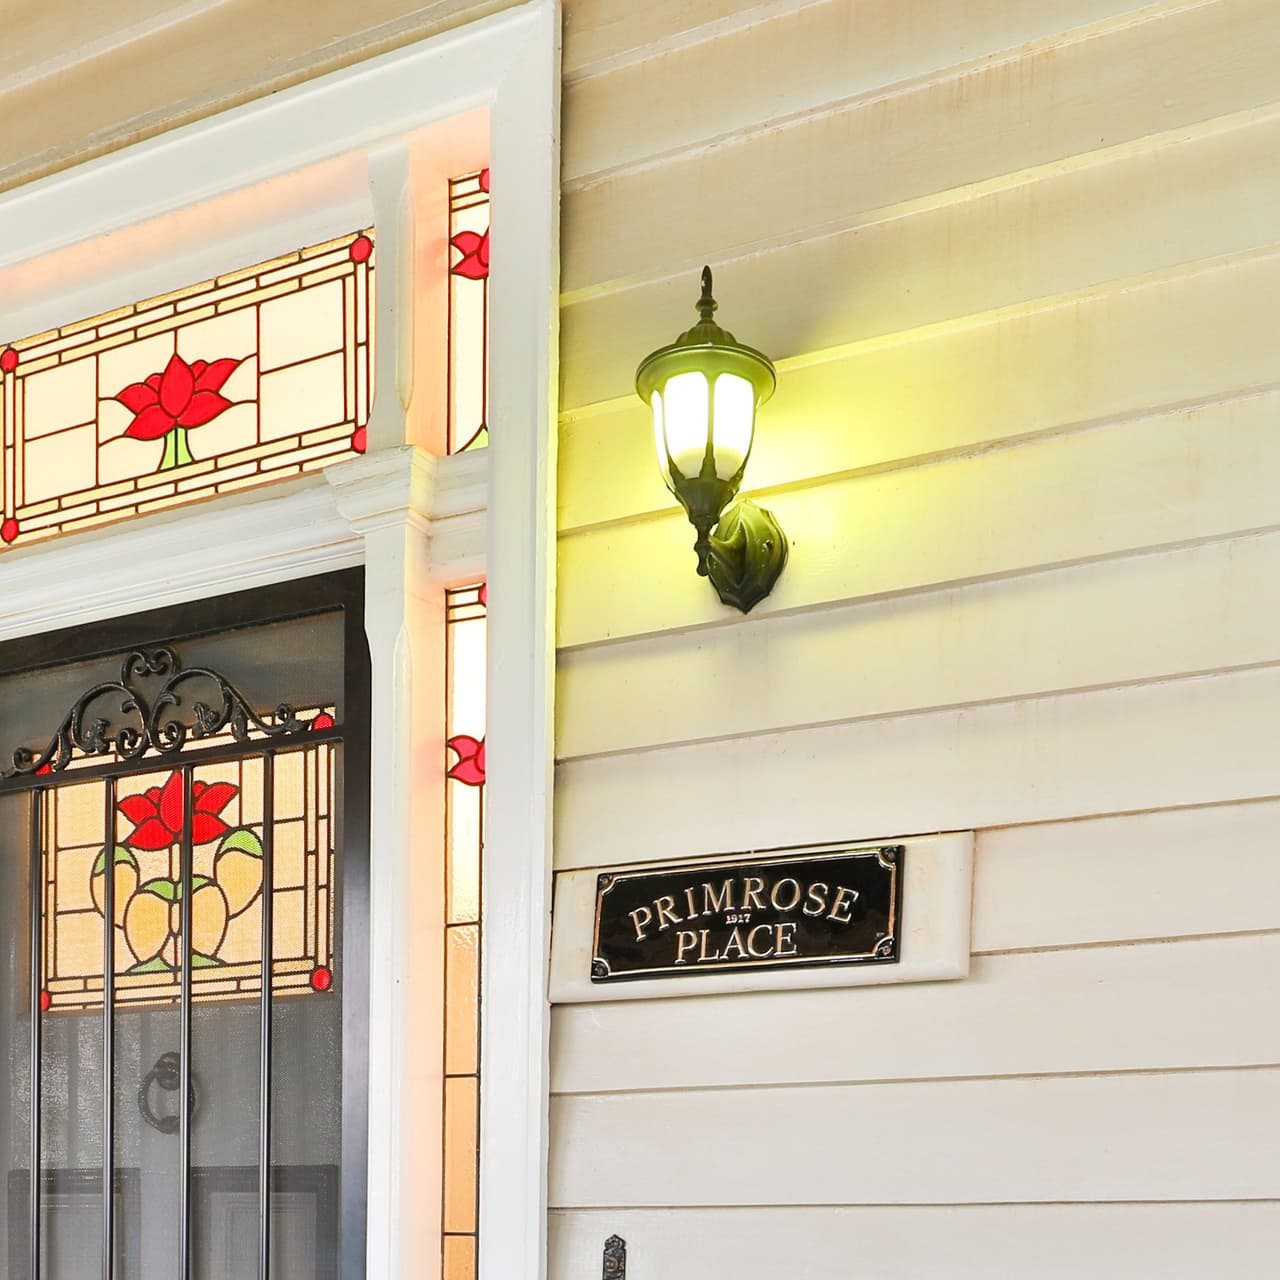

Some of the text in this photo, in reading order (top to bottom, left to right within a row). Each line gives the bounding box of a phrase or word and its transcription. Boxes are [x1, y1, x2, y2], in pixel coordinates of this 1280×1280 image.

[628, 877, 860, 943] PRIMROSE
[725, 913, 751, 924] 1917
[674, 922, 798, 965] PLACE
